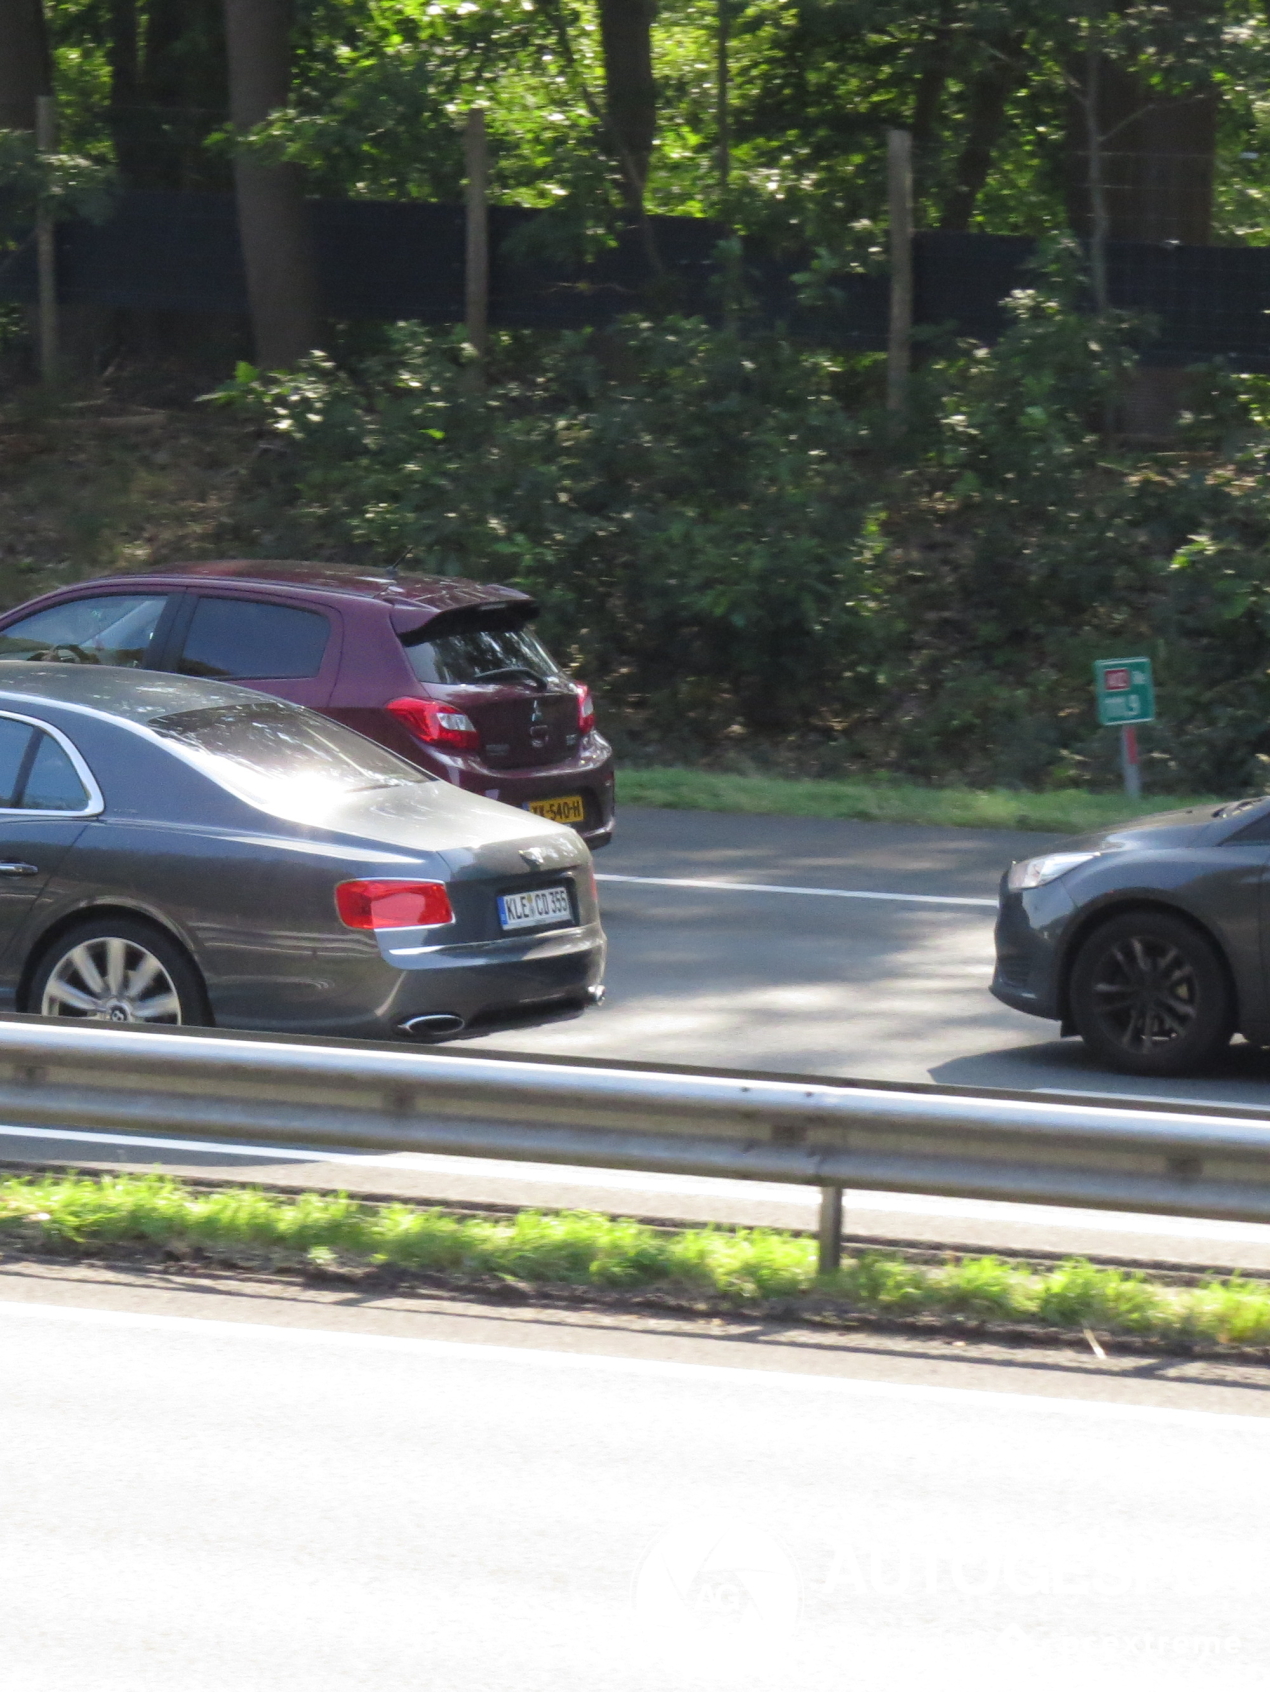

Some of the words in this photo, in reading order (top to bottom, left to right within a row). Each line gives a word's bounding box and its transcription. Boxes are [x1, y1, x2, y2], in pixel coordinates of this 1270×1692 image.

[505, 896, 529, 920] KLE
[535, 893, 549, 915] CD
[550, 890, 568, 914] 355
